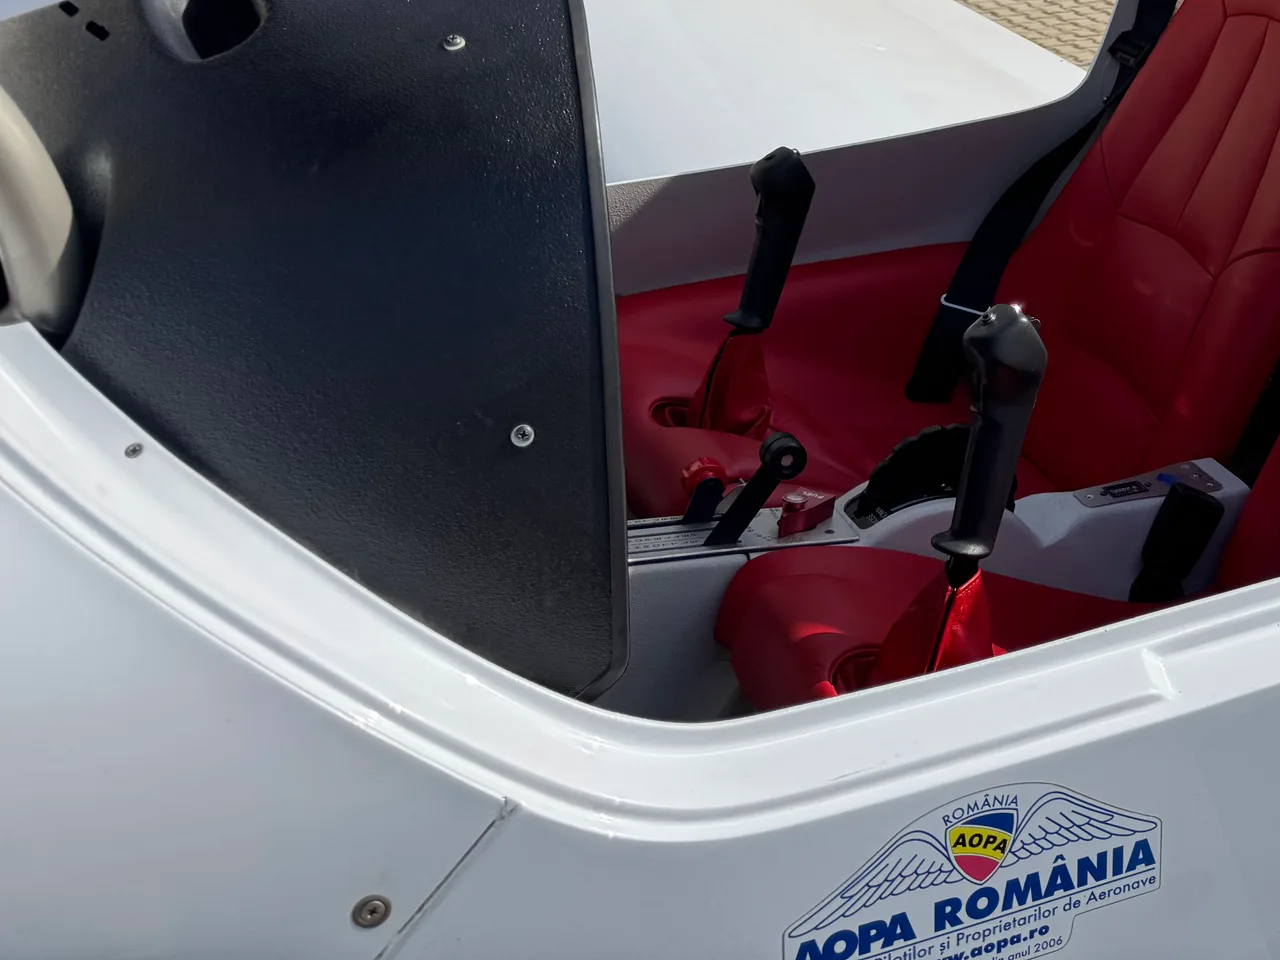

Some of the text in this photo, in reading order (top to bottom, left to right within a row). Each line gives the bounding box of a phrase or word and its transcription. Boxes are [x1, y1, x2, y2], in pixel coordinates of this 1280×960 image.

[802, 490, 825, 499] FUEL
[942, 793, 1019, 826] ROMÂNIA
[951, 832, 1008, 855] AOPA
[795, 838, 1156, 960] AOPA ROMÂNIA
[939, 935, 950, 956] și
[956, 906, 1058, 946] Proprietarilor
[1063, 897, 1081, 912] de
[1085, 875, 1156, 905] Aeronave
[1033, 935, 1063, 954] 2006
